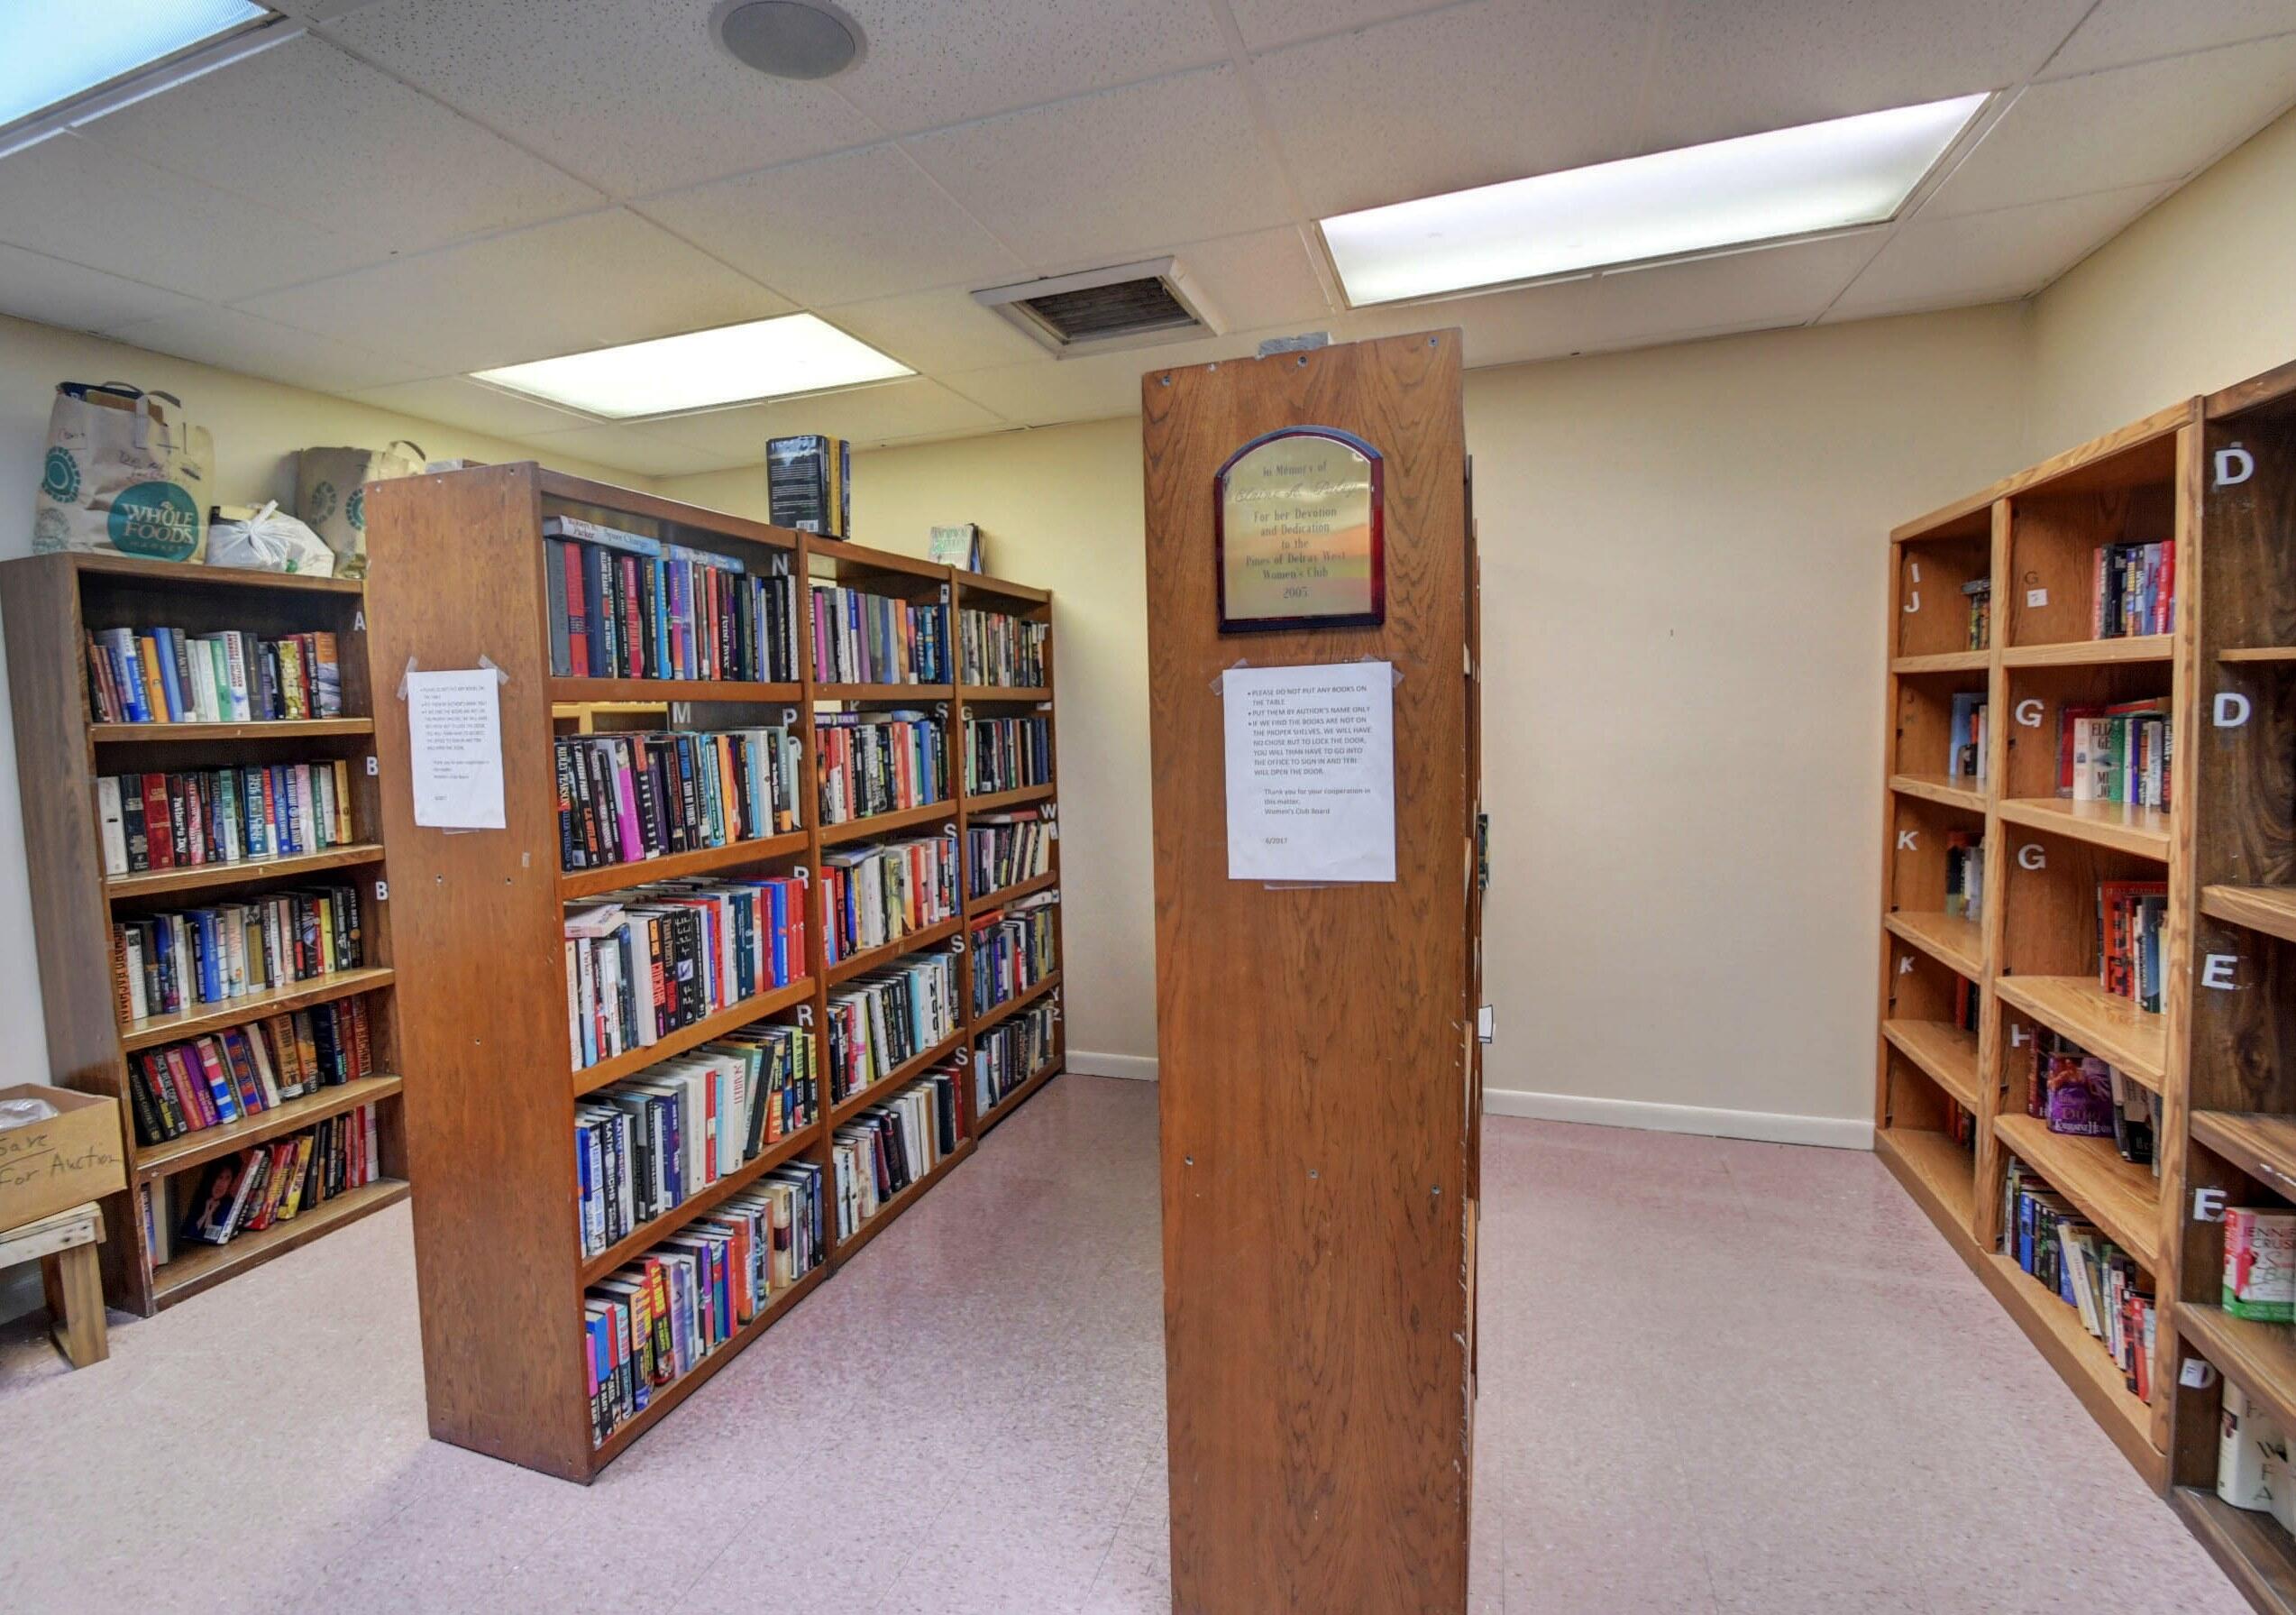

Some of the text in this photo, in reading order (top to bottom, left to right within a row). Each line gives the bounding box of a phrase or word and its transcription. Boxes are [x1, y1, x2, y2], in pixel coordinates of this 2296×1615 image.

[1276, 463, 1313, 476] Memory
[1318, 462, 1327, 473] of
[2214, 446, 2254, 485] D
[122, 503, 195, 528] WHOLE
[1254, 512, 1269, 522] For
[1275, 509, 1289, 520] her
[123, 522, 196, 544] FOODS
[772, 553, 788, 576] N
[1903, 591, 1920, 613] J
[352, 611, 366, 630] A
[672, 702, 691, 723] M
[782, 708, 798, 728] P
[2015, 698, 2044, 728] G
[2213, 692, 2251, 727] D
[366, 757, 379, 775] B
[1039, 803, 1057, 820] W
[172, 796, 188, 853] Father's Day
[944, 823, 957, 838] S
[1897, 830, 1918, 850] K
[2017, 843, 2046, 870] G
[375, 880, 388, 900] B
[951, 935, 965, 952] S
[1899, 956, 1915, 974] K
[2201, 953, 2237, 990] E
[115, 971, 131, 1023] BACHMAN
[797, 1005, 813, 1027] R
[955, 1046, 968, 1066] S
[604, 1122, 613, 1152] KATH
[2193, 1188, 2227, 1220] E
